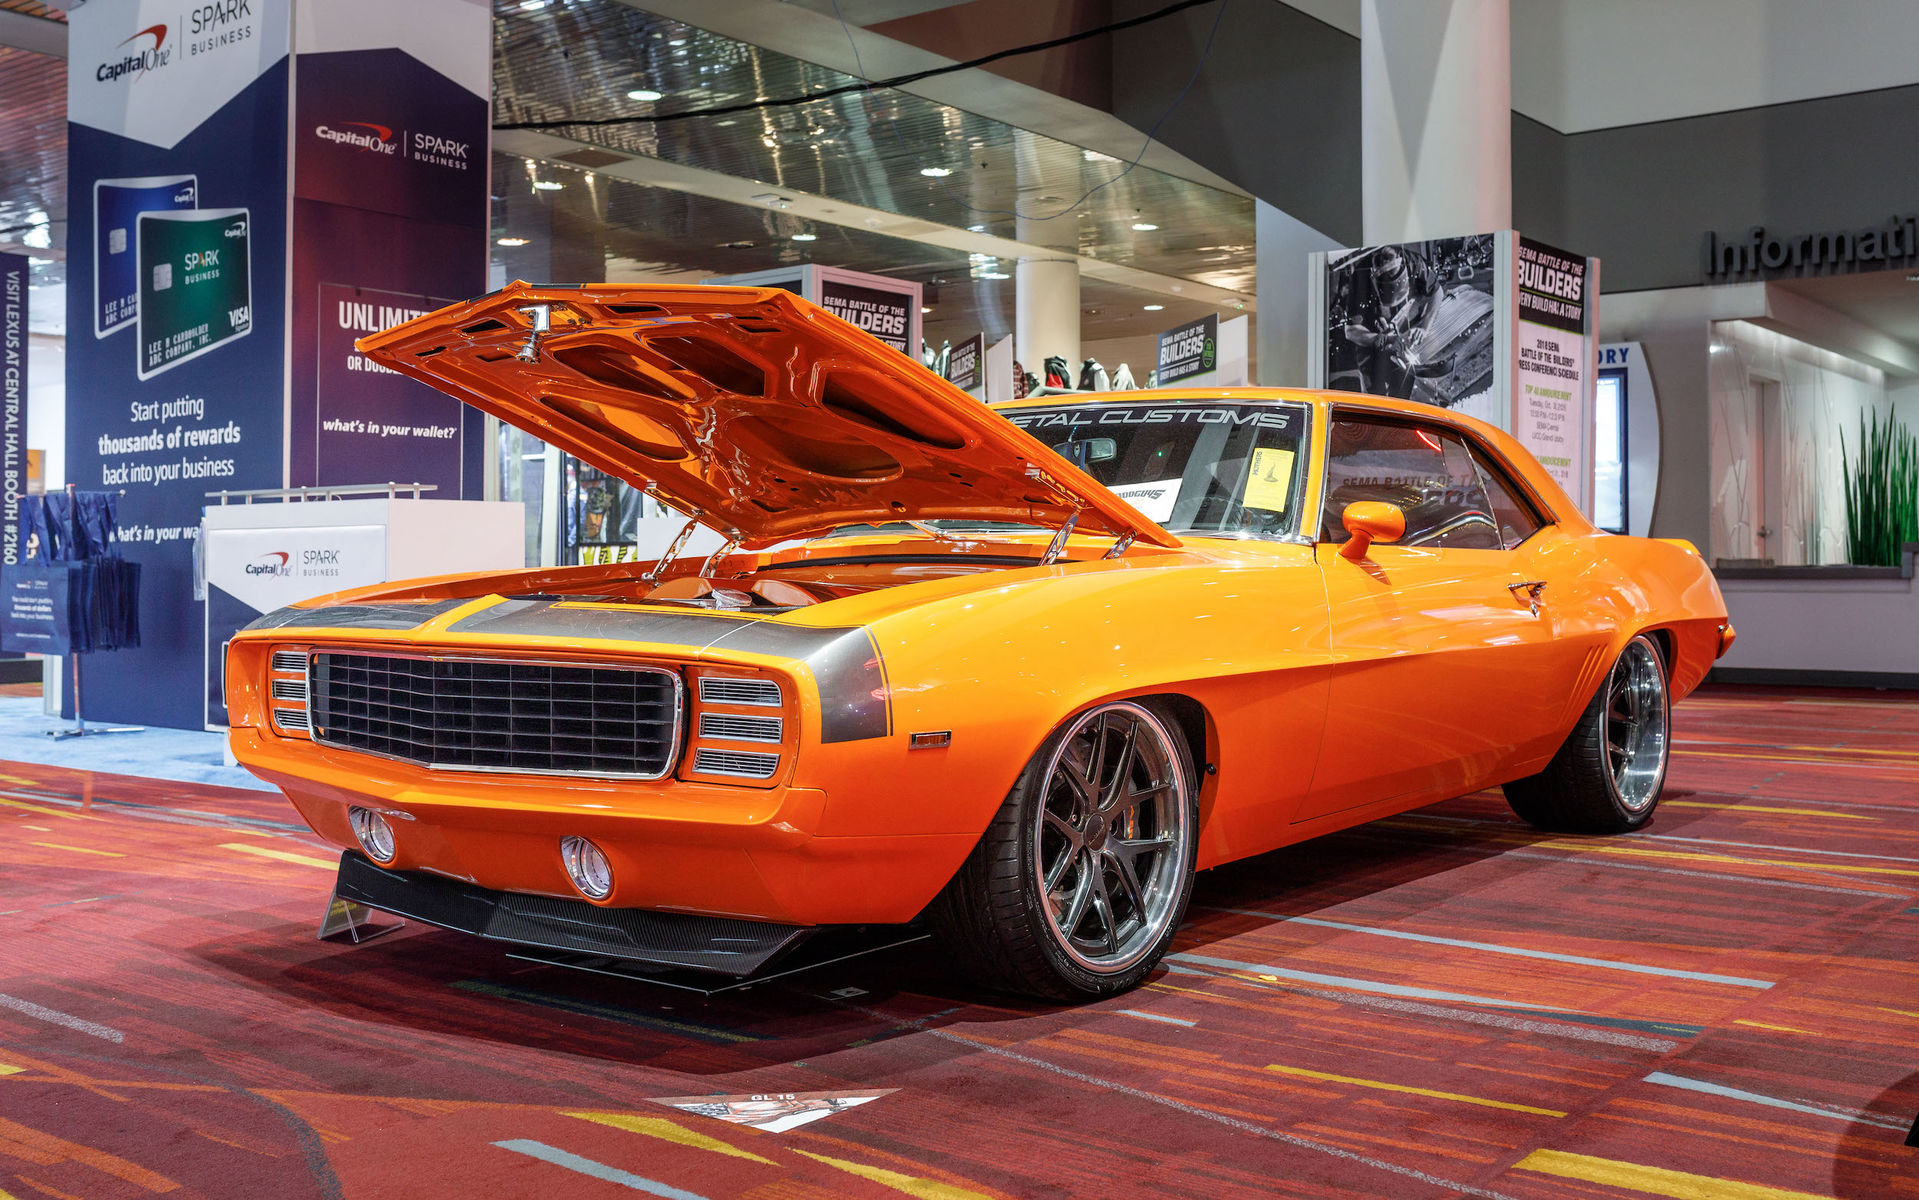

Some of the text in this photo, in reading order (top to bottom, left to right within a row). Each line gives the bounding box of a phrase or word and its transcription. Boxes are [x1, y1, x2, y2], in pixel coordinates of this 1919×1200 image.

[191, 0, 251, 34] SPARK
[191, 26, 251, 56] BUSINESS
[415, 133, 467, 159] SPARK
[414, 151, 467, 170] BUSINESS
[1704, 215, 1916, 274] Informati
[185, 250, 219, 271] SPARK
[1519, 246, 1583, 276] SEMA BATTLE OF THE
[185, 269, 220, 285] BUSINESS
[1519, 260, 1581, 301] BUILDERS
[228, 306, 249, 327] VISA
[824, 296, 905, 316] SEMA BATTLE OF THE
[1532, 295, 1548, 312] BUILD
[1548, 299, 1559, 315] HAS
[1560, 303, 1565, 317] A
[1565, 304, 1582, 320] STORY
[149, 340, 162, 355] LEE
[1160, 334, 1204, 366] BUILDERS
[1521, 347, 1537, 360] BATTLE
[1538, 351, 1543, 361] OF
[1548, 341, 1559, 352] SEMA
[149, 353, 162, 367] ABC
[347, 355, 362, 371] OR
[1519, 359, 1579, 381] RESS CONFERENCE SCHEDULE
[3, 271, 20, 566] VISIT LEXUS AT CENTRAL HALL BOOTH #2160
[130, 394, 204, 424] Start putting
[1099, 409, 1290, 429] CUSTOMS
[98, 420, 241, 455] thousands of rewards
[323, 419, 455, 439] what's in your wallet?
[103, 456, 234, 486] back into your business
[143, 525, 154, 542] in
[155, 526, 182, 544] your
[303, 550, 339, 565] SPARK
